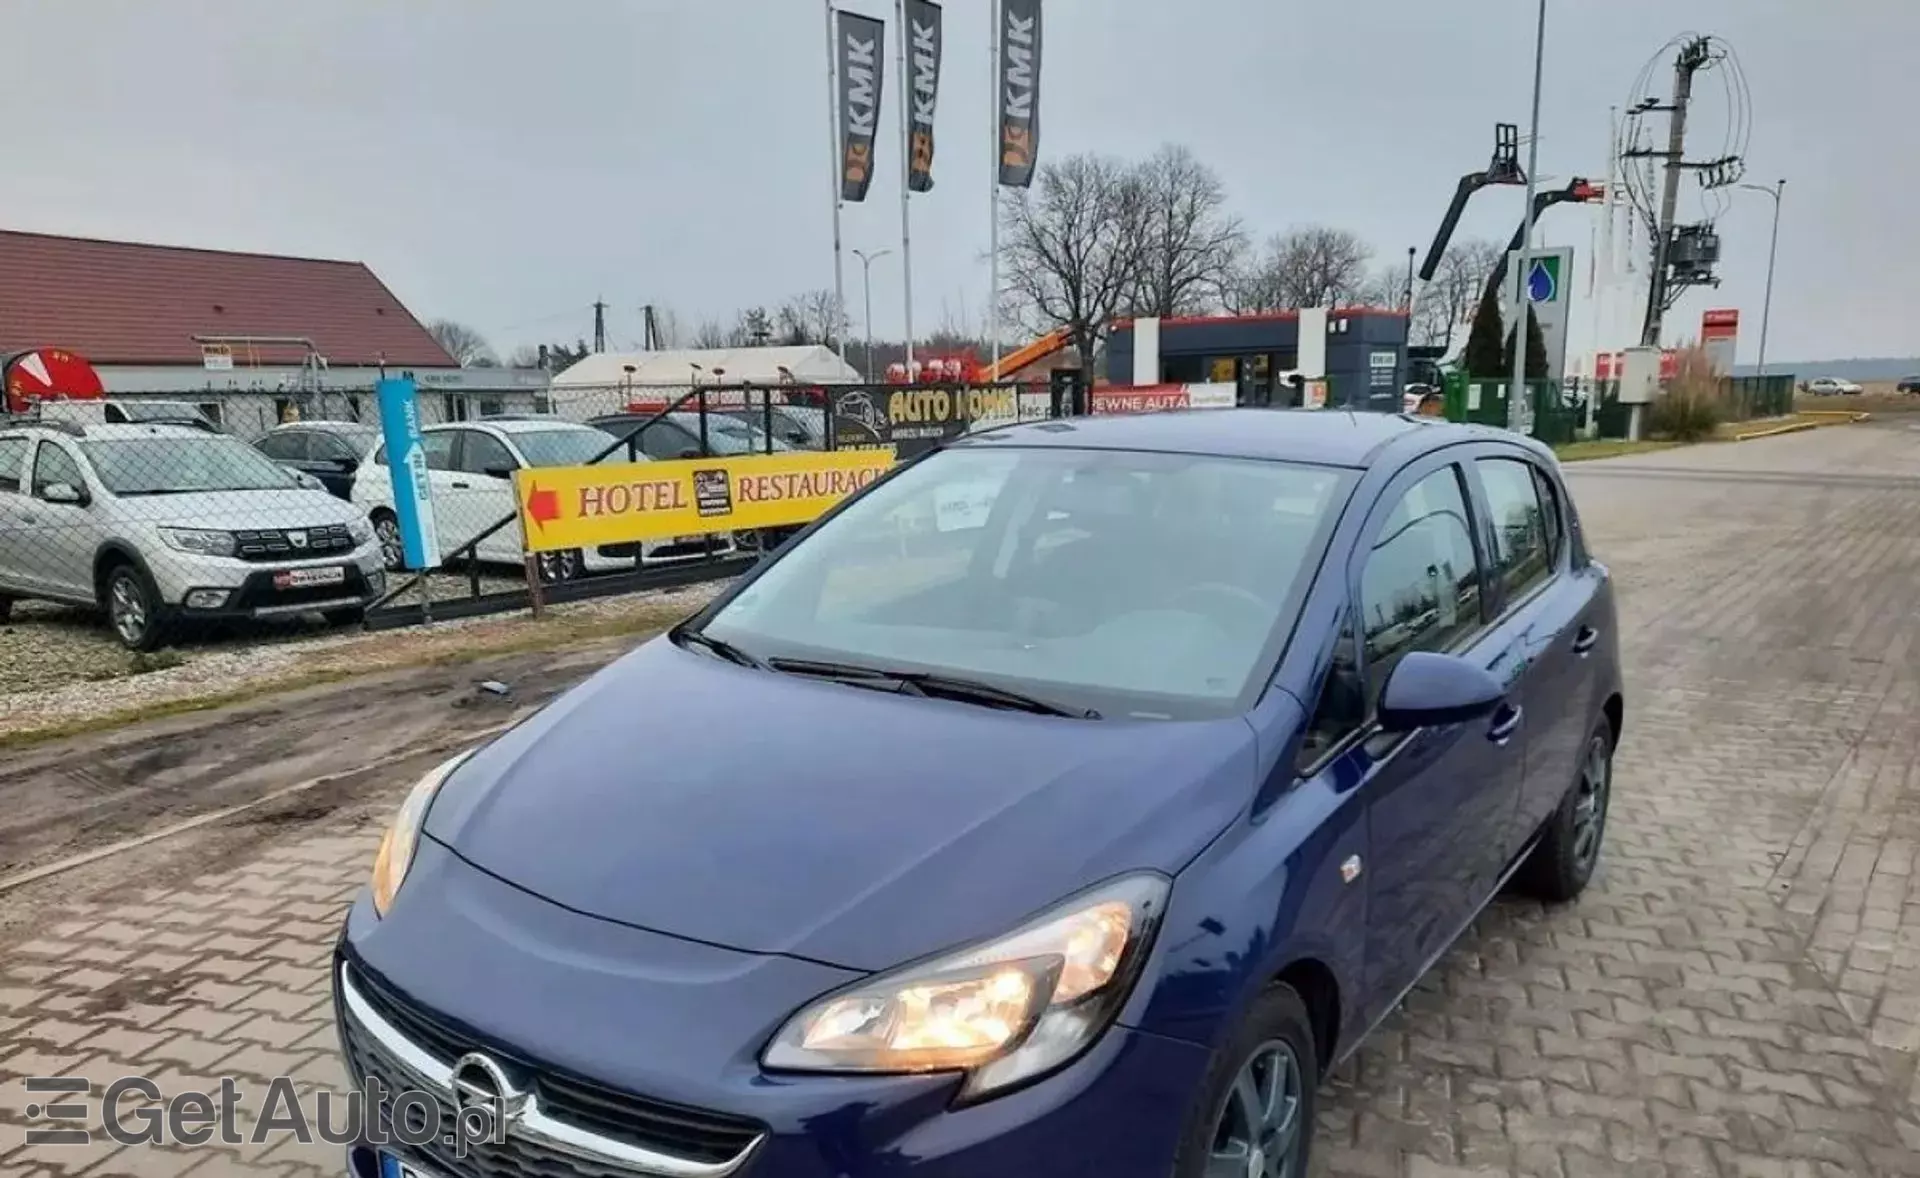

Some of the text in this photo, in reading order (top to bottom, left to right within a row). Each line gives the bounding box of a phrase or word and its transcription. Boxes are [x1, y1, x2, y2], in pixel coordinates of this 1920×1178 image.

[847, 33, 875, 136] KMK
[911, 17, 934, 125] KMK
[1006, 9, 1034, 118] KMK
[889, 389, 950, 424] AUTO
[1144, 392, 1188, 408] AUTA
[578, 479, 688, 518] HOTEL
